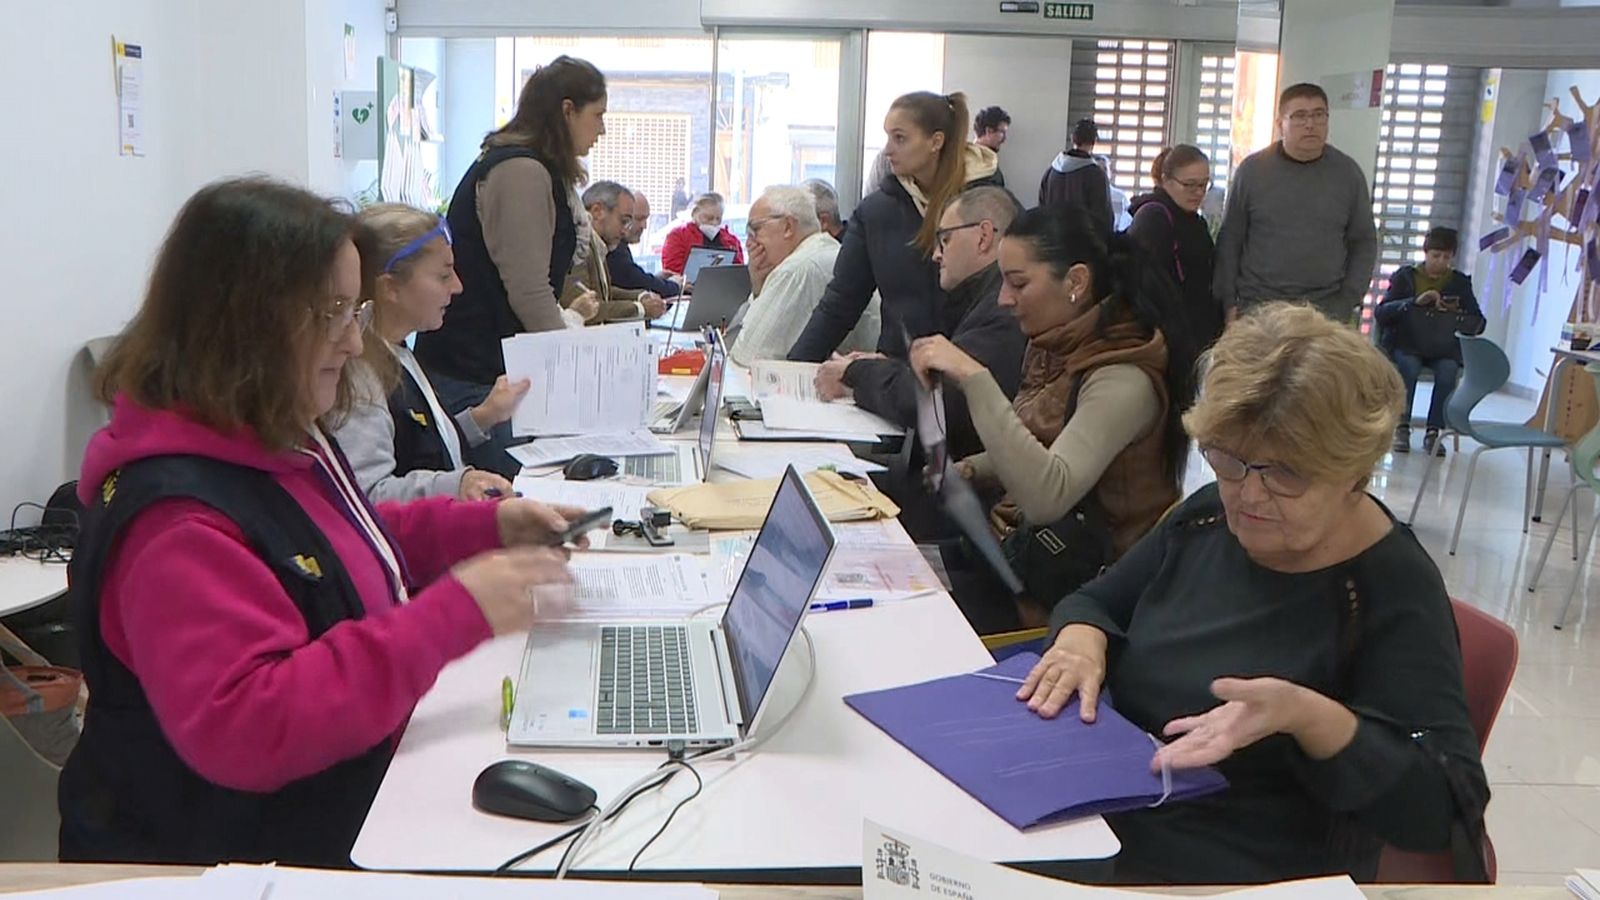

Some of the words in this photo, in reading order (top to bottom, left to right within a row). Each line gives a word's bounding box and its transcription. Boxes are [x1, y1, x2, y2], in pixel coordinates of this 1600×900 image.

[1047, 4, 1090, 18] SALIDA
[929, 872, 971, 891] GOBIERNO
[931, 884, 942, 894] DE
